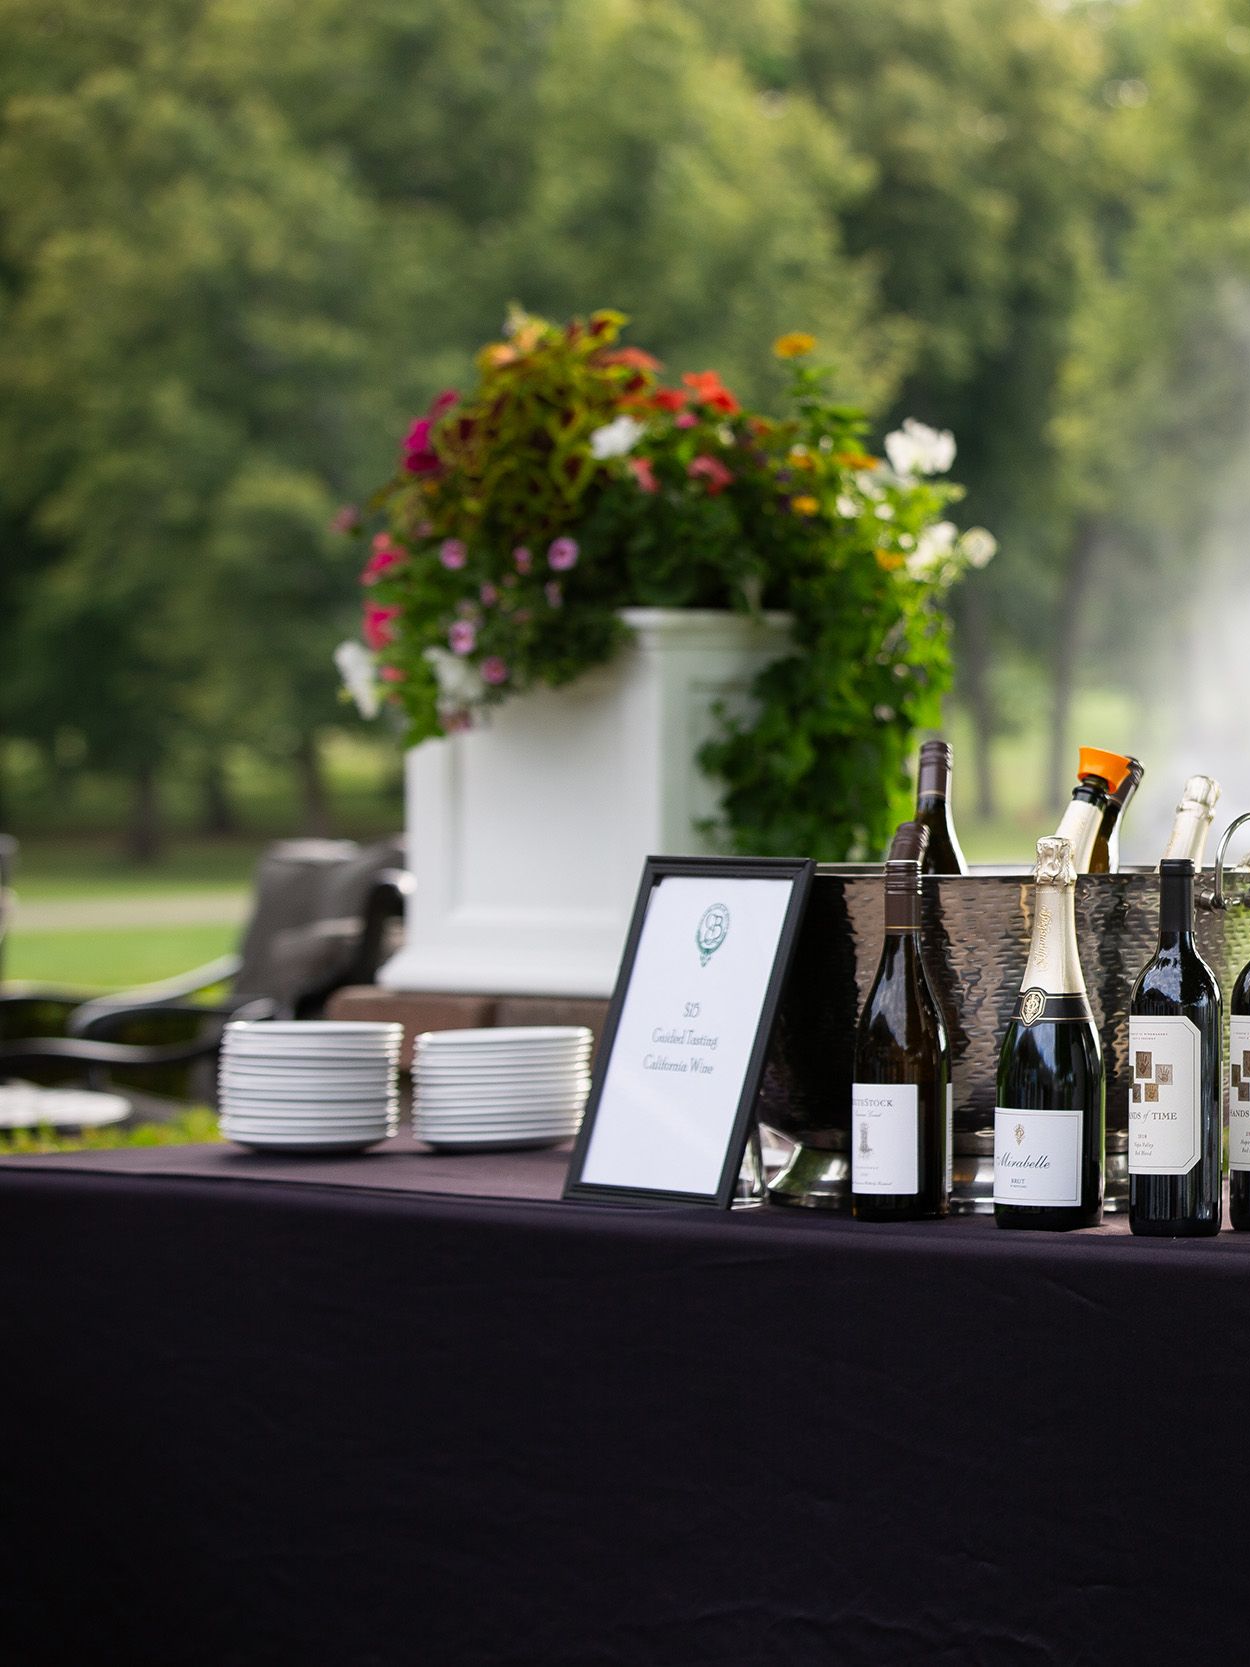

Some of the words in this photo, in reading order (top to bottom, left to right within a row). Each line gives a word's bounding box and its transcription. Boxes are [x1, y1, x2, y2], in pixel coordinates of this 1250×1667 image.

[652, 1027, 686, 1044] Guided
[686, 1029, 719, 1050] Tasting
[643, 1054, 688, 1072] California
[689, 1057, 714, 1074] Wine
[1152, 1112, 1177, 1120] TIME
[997, 1152, 1050, 1169] Mirabelle
